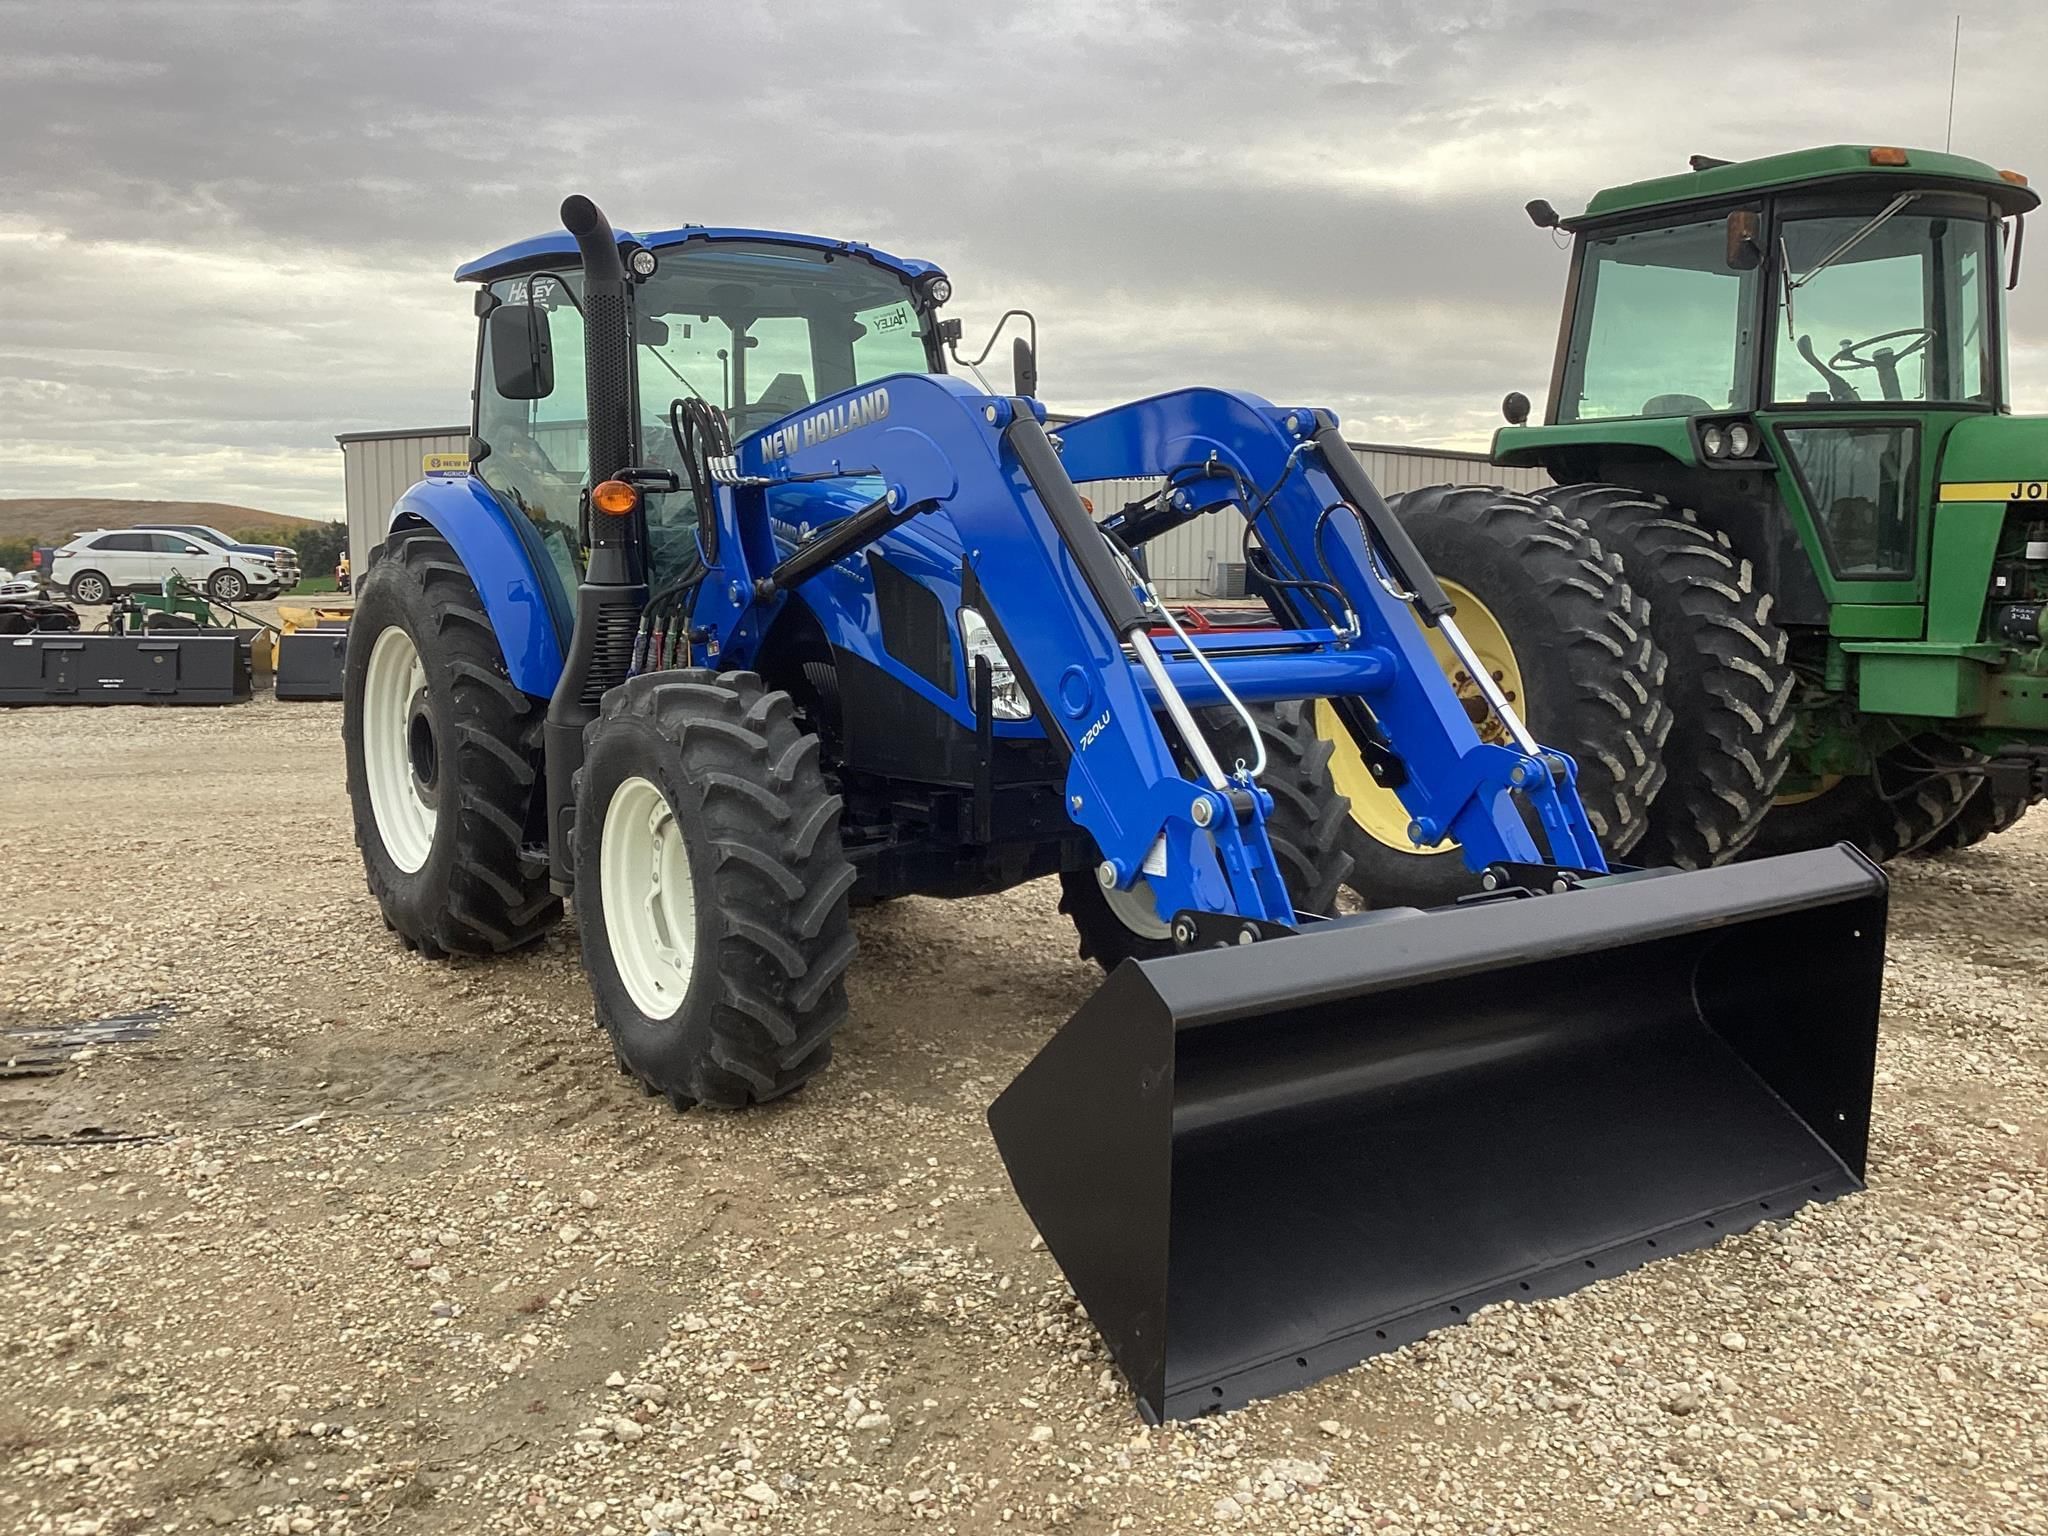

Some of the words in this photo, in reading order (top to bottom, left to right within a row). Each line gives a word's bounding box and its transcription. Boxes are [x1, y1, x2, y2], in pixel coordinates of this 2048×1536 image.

[508, 282, 555, 302] HAEY
[760, 423, 799, 464] NEW
[803, 387, 890, 448] HOLLAND
[2010, 483, 2048, 500] JO
[1080, 709, 1111, 752] 720LU
